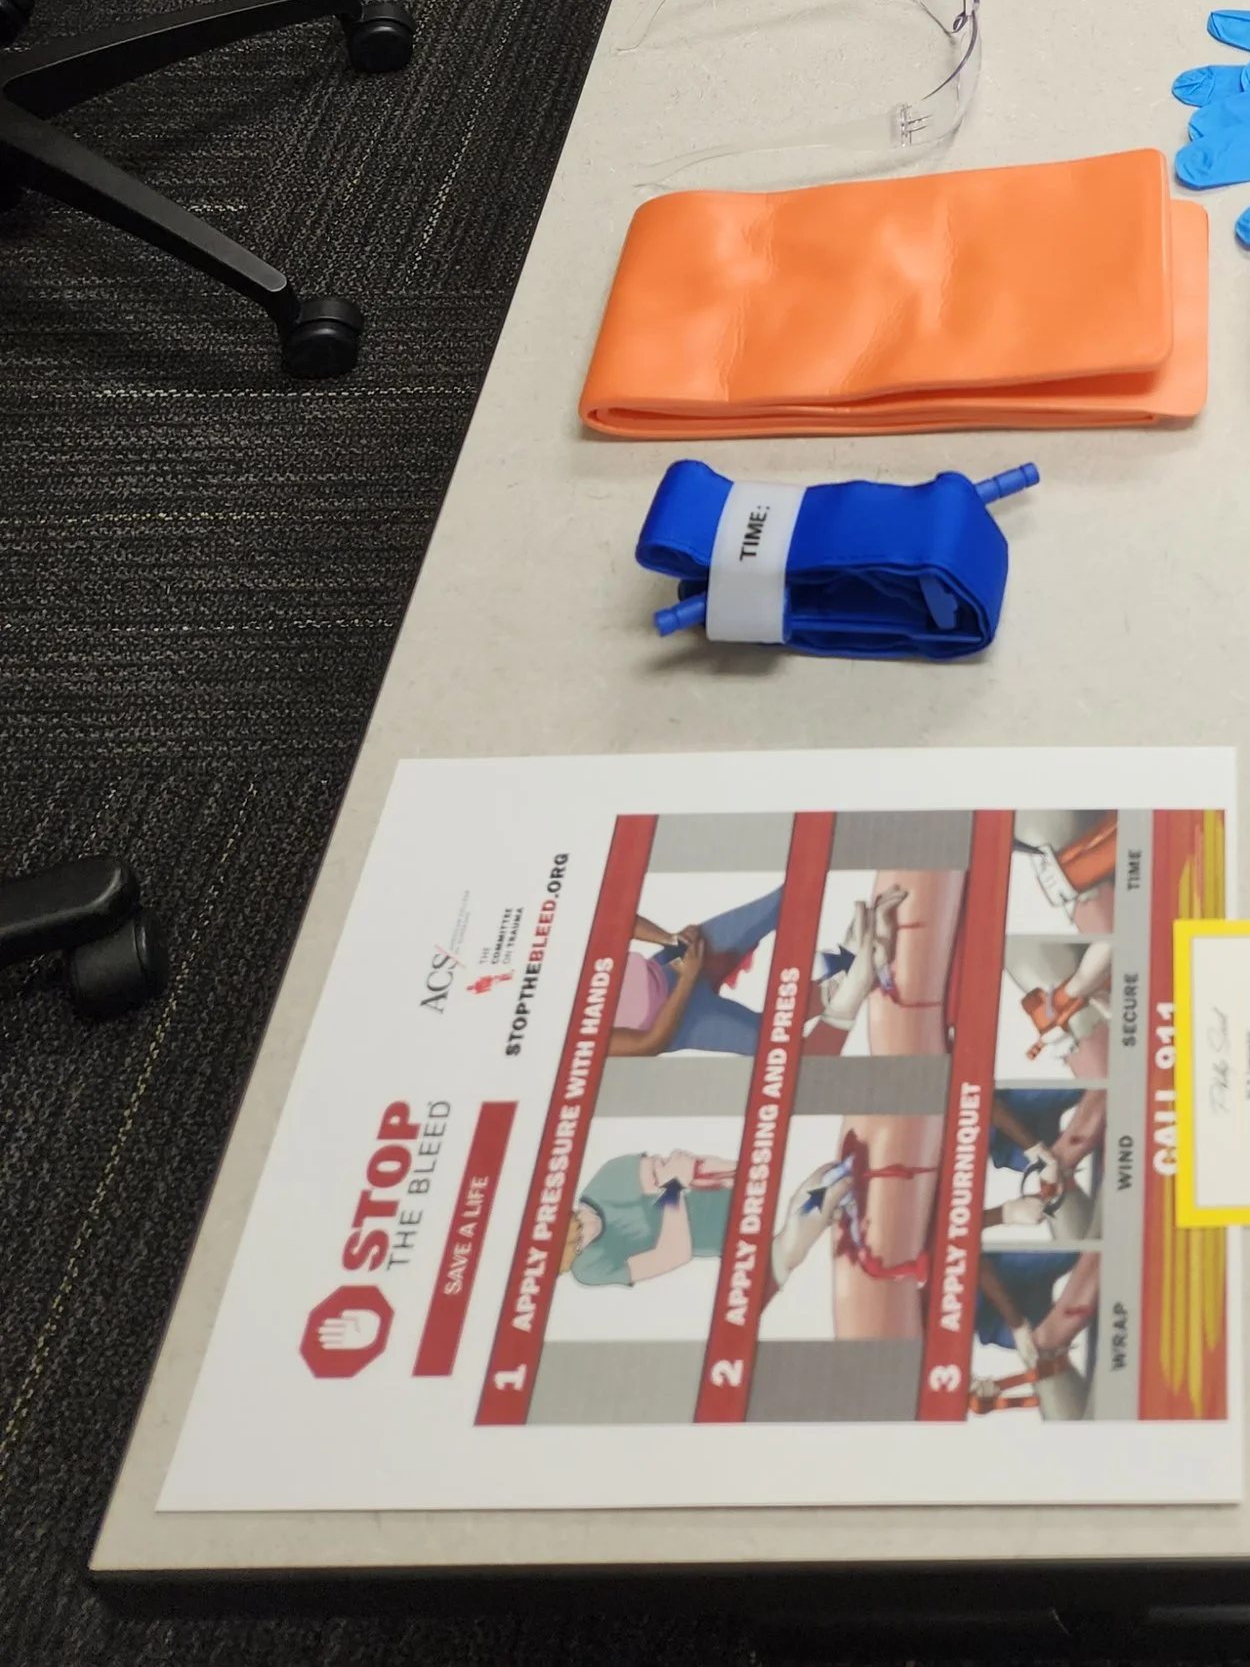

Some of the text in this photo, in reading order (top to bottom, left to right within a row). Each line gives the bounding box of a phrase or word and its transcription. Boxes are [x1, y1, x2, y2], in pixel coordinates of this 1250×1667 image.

[738, 505, 770, 562] TIME:
[419, 953, 460, 1015] ACS
[479, 947, 490, 965] THE
[490, 907, 513, 965] COMMITTEE
[504, 853, 569, 1058] STOPTHEBLEED.ORG
[506, 907, 524, 947] TRAUMA
[341, 1100, 421, 1272] STOP
[386, 1100, 452, 1271] THE BLEED
[494, 957, 614, 1391] 1 APPLY PRESSURE WITH HANDS
[711, 967, 801, 1387] 2 APPLY DRESSING AND PRESS
[1110, 849, 1142, 1371] WRAP WIND SECURE TIME
[443, 1176, 489, 1295] SAVE A LIFE
[929, 1081, 982, 1392] 3 APPLY TOURNIQUET
